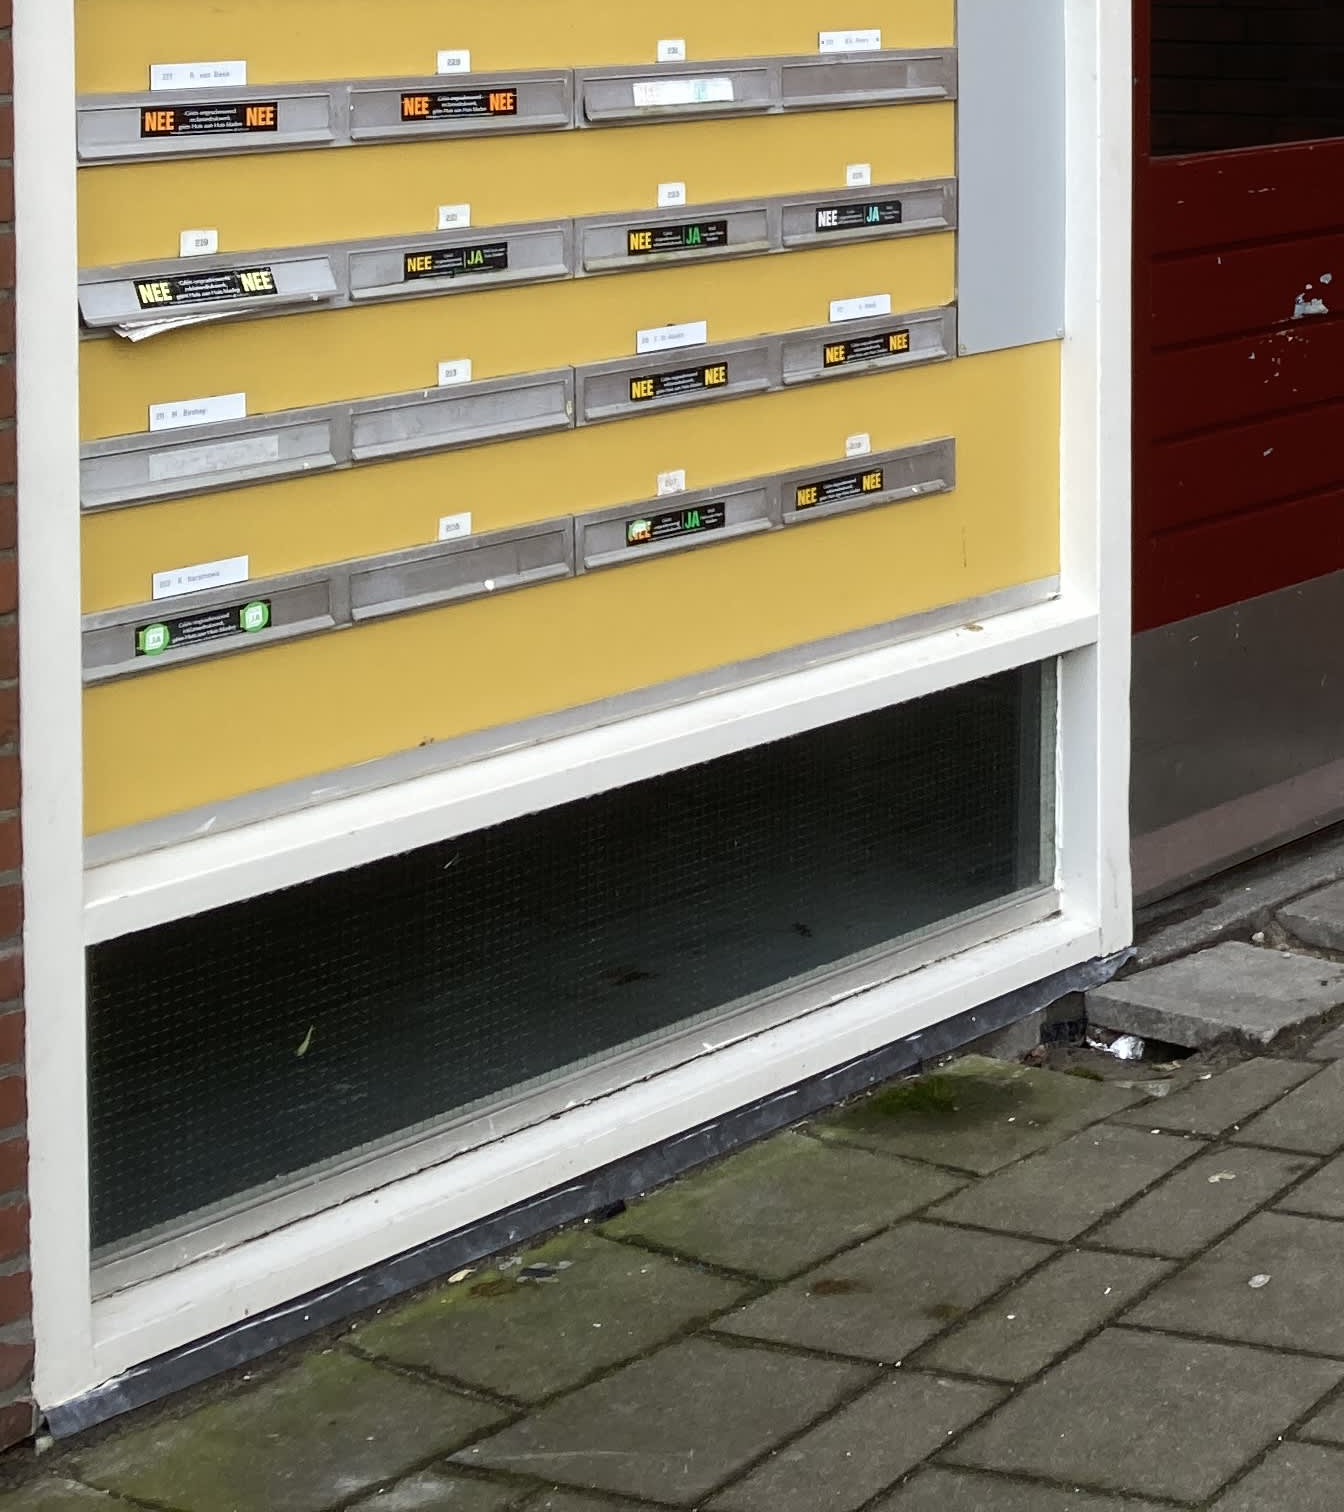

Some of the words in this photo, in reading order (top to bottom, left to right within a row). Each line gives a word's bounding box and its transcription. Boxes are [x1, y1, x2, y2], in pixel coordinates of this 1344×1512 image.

[404, 96, 429, 116] NEE
[489, 92, 514, 111] NEE
[145, 111, 175, 132] NEE
[246, 106, 274, 126] NEE
[818, 209, 838, 227] NEE
[866, 206, 880, 223] JA
[630, 231, 652, 250] NEE
[686, 226, 701, 245] JA
[407, 255, 432, 273] NEE
[467, 250, 484, 265] JA
[240, 271, 273, 292] NEE
[138, 282, 173, 304] NEE
[889, 333, 908, 352] NEE
[825, 345, 845, 364] NEE
[704, 366, 726, 386] NEE
[631, 379, 654, 399] NEE
[862, 472, 881, 491] NEE
[797, 487, 817, 506] NEE
[685, 510, 700, 529] JA
